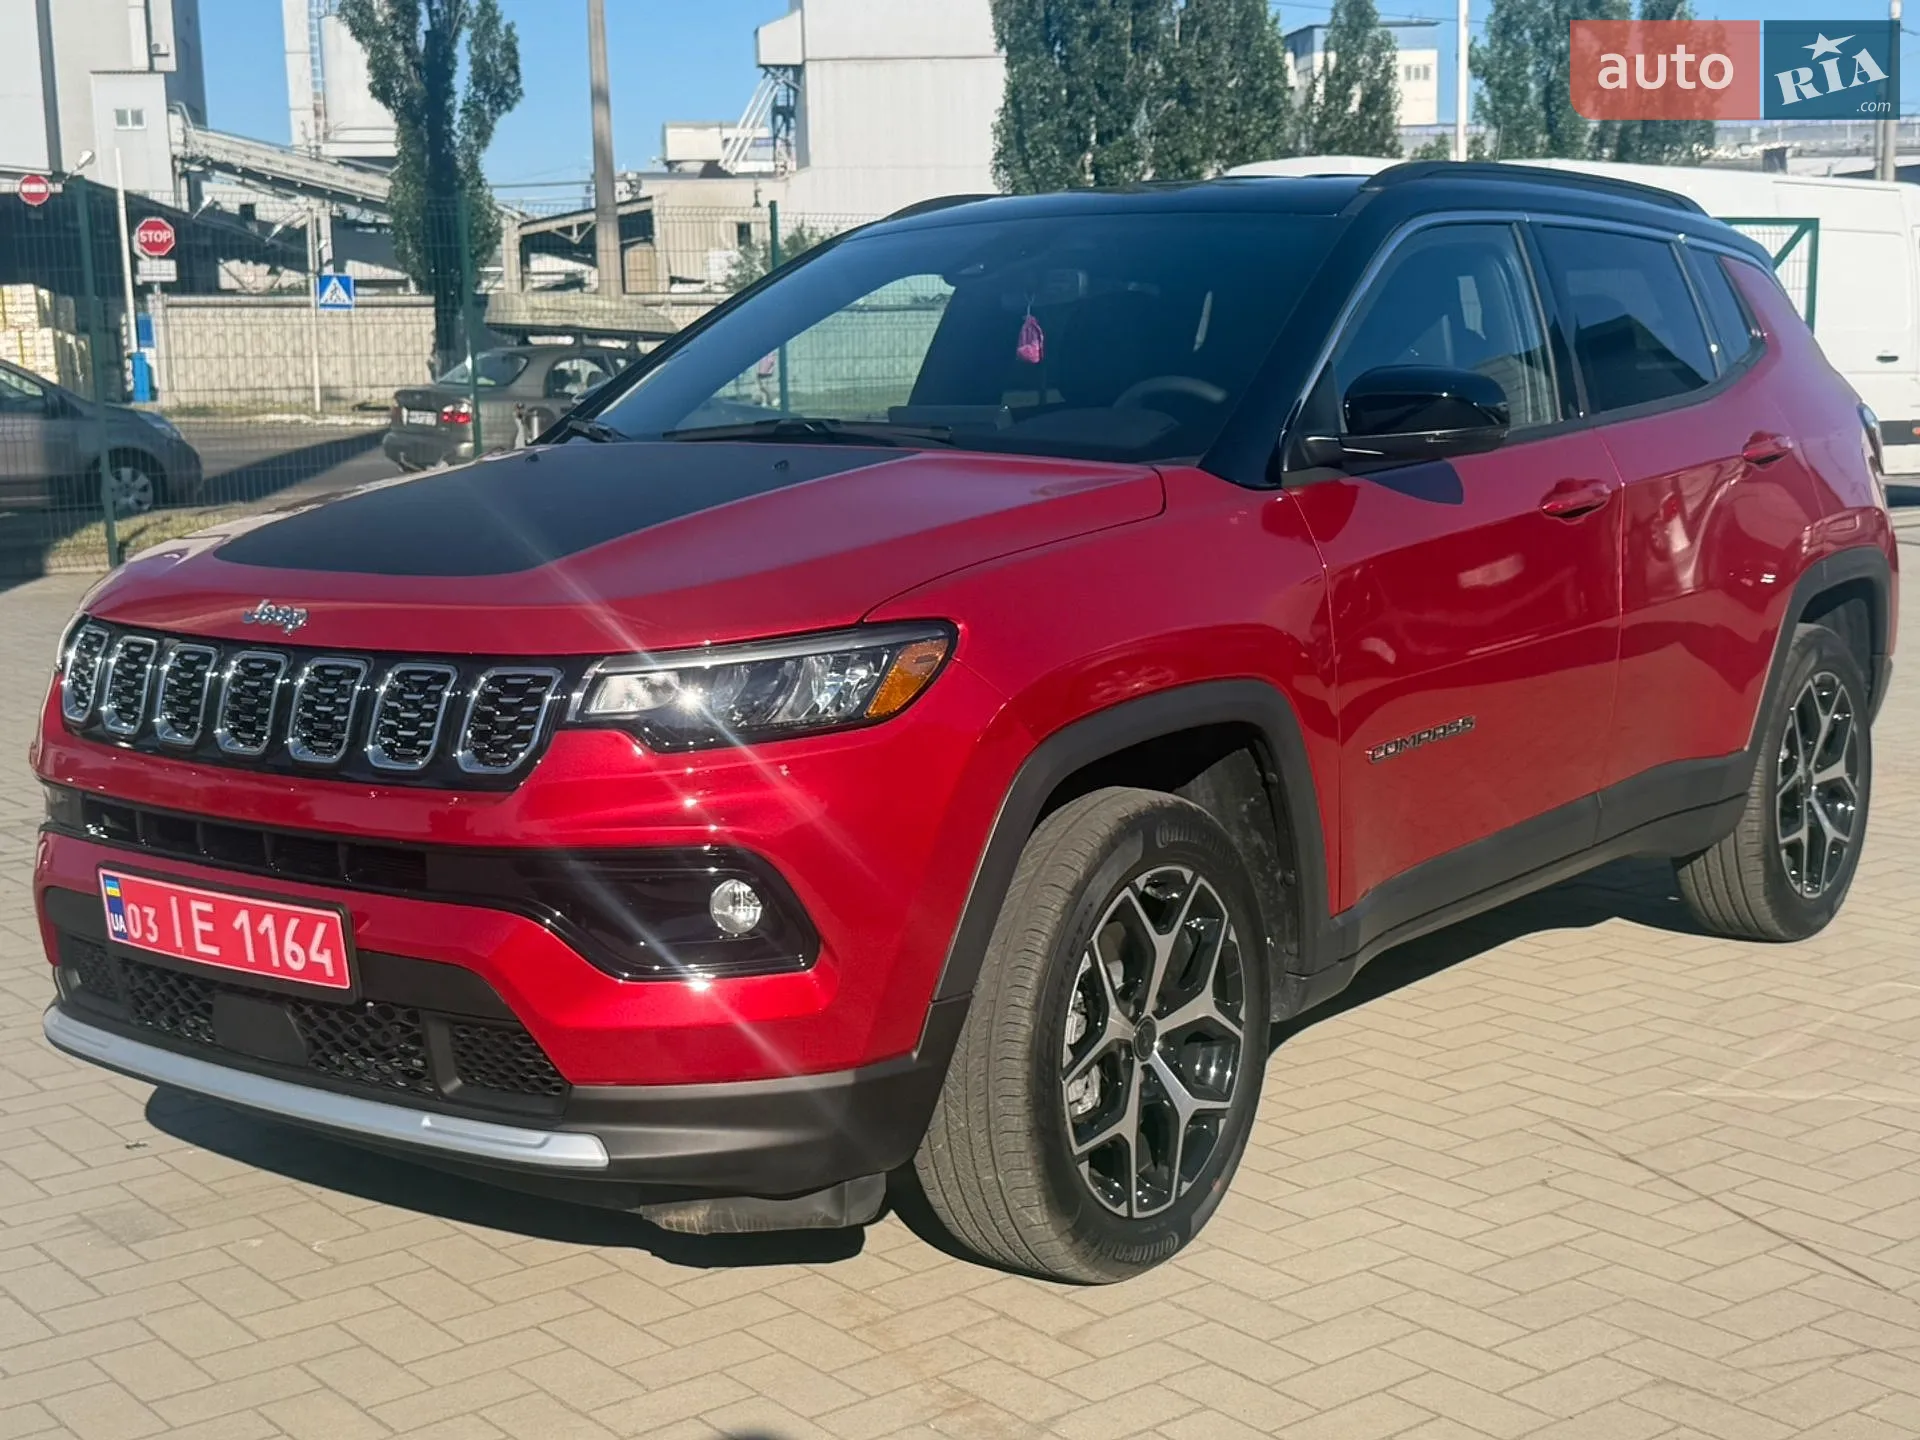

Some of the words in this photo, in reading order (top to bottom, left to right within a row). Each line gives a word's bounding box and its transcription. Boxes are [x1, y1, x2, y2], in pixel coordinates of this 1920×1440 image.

[140, 229, 171, 243] STOP
[242, 599, 308, 634] Jeep
[1366, 715, 1475, 763] COMPASS
[110, 912, 127, 933] UA
[127, 902, 159, 944] 03
[170, 895, 221, 957] IE
[232, 909, 335, 978] 1164
